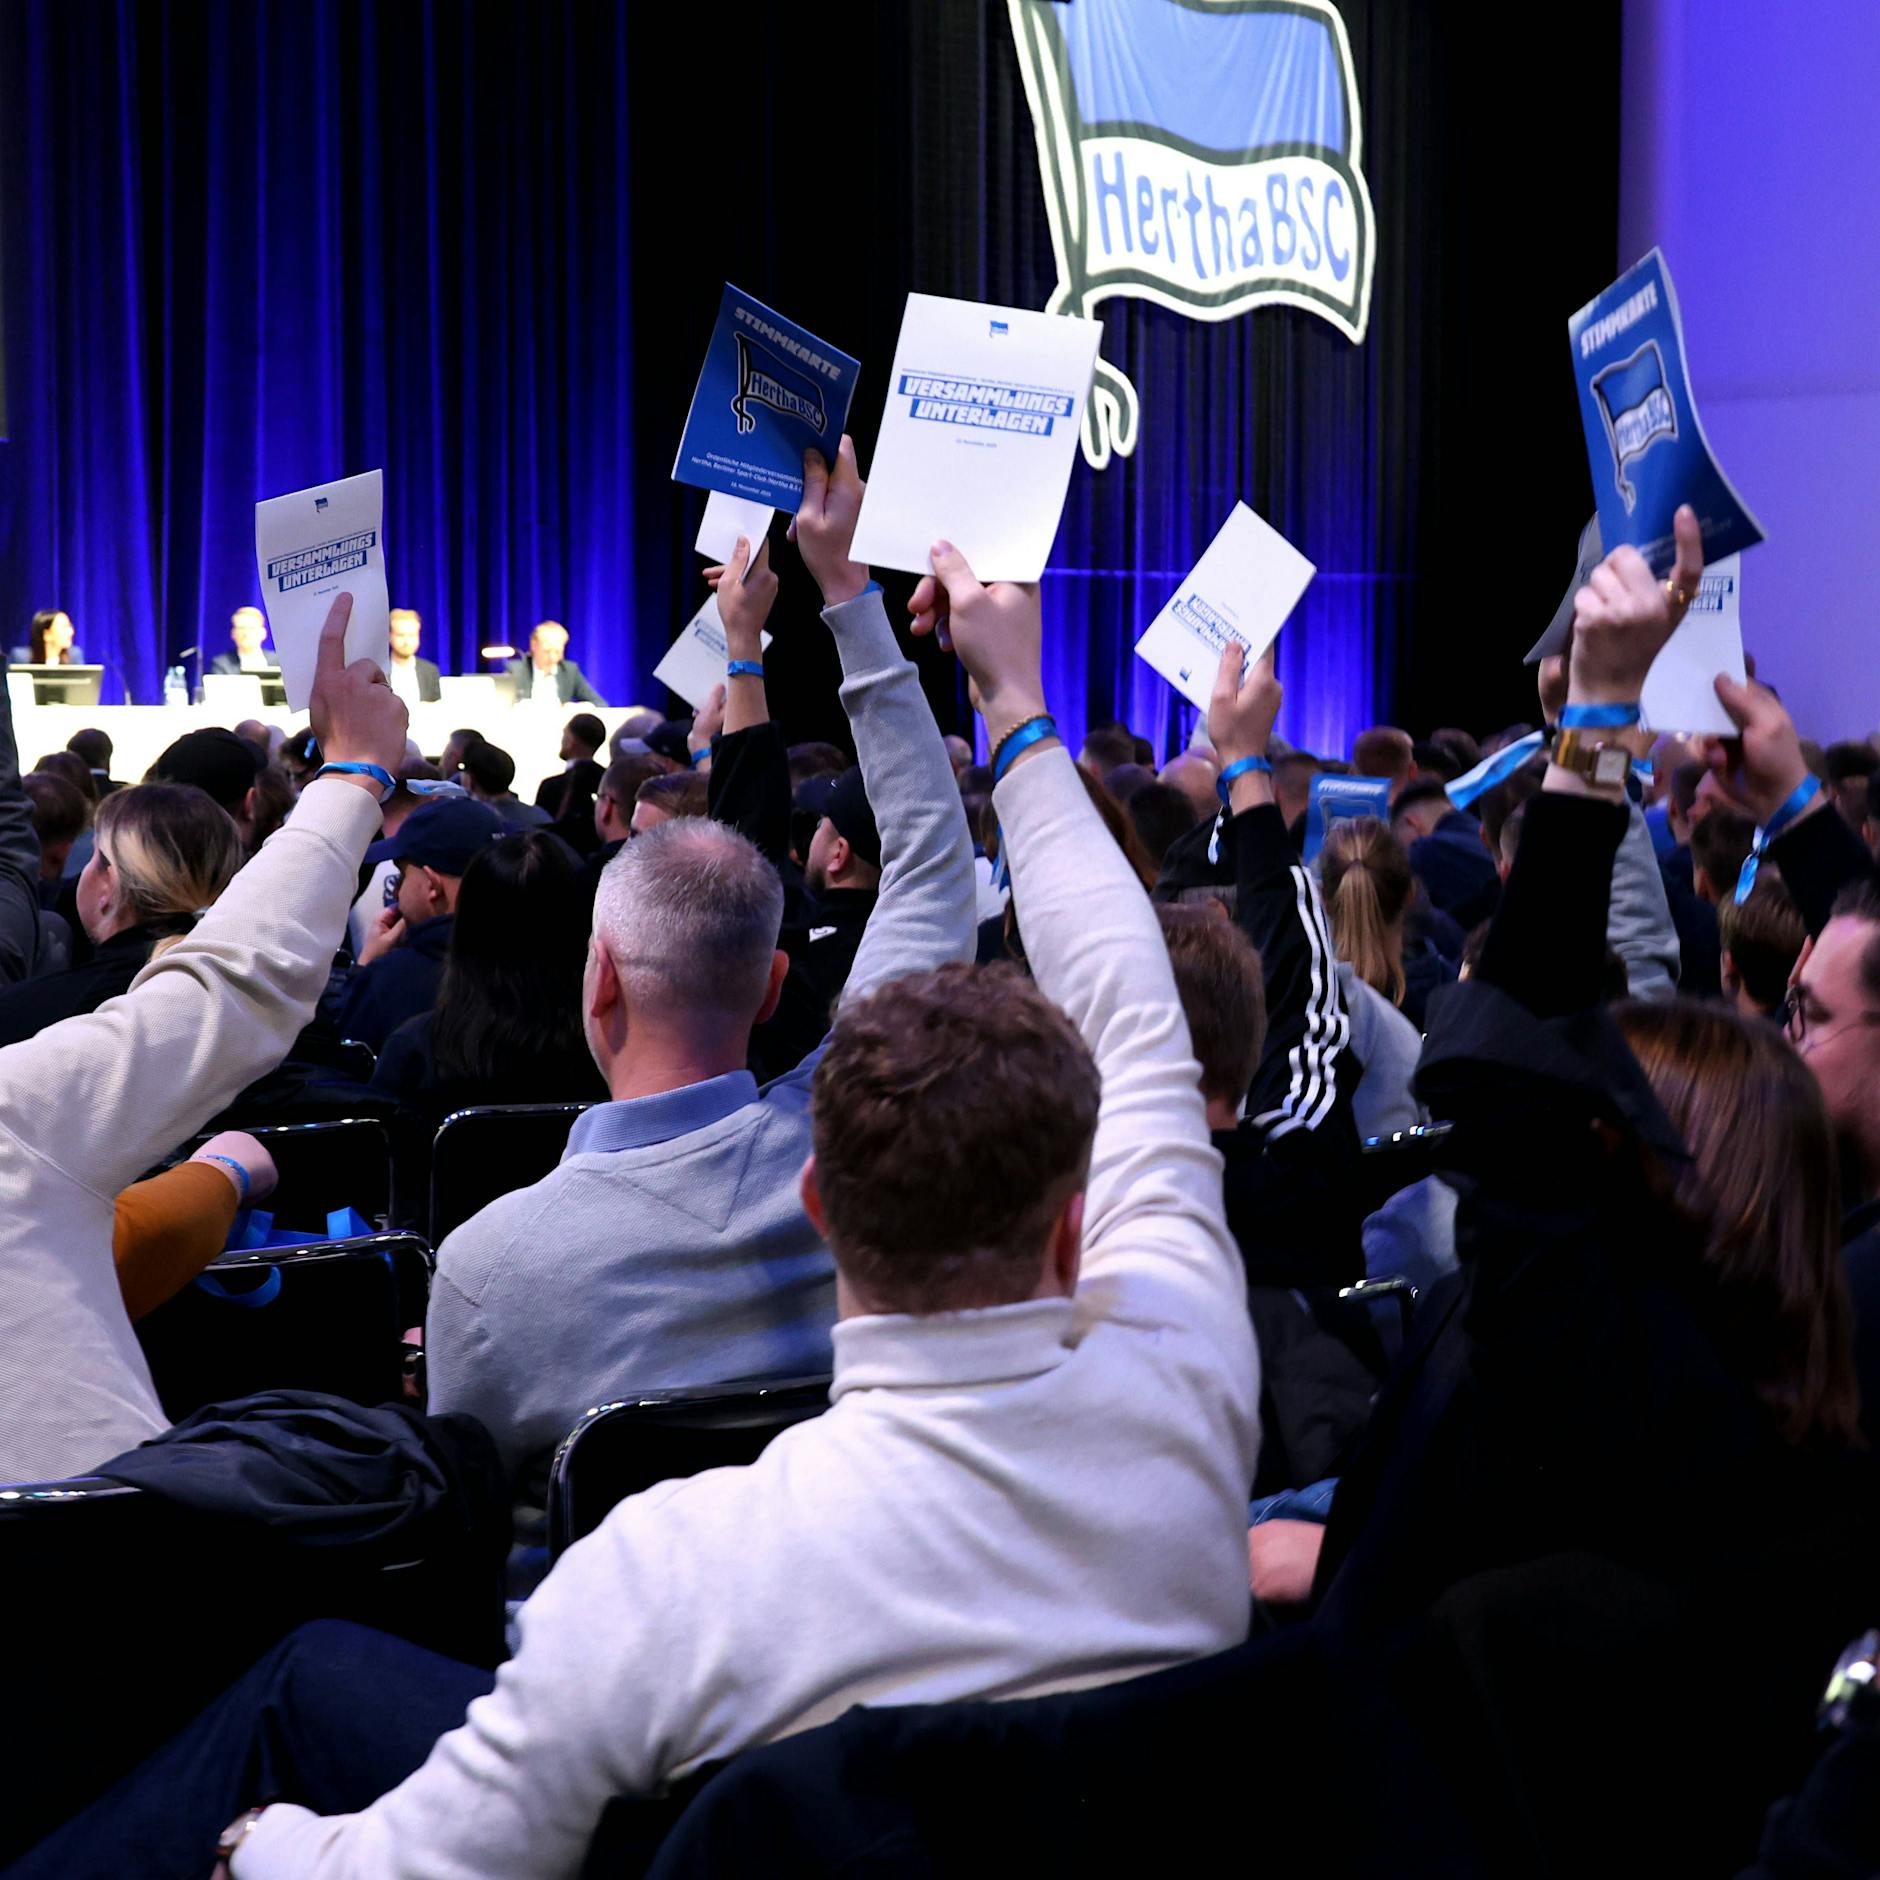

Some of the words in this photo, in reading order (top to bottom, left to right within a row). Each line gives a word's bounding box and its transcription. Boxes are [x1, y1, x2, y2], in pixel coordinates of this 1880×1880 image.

[734, 306, 842, 381] STIMMKARTE
[904, 376, 1069, 416] VERSAMMLUNGS
[915, 401, 1049, 434] UNTERLAGEN
[271, 533, 373, 577] VERSAMMLUNGS
[282, 552, 363, 590] UNTERLAGEN
